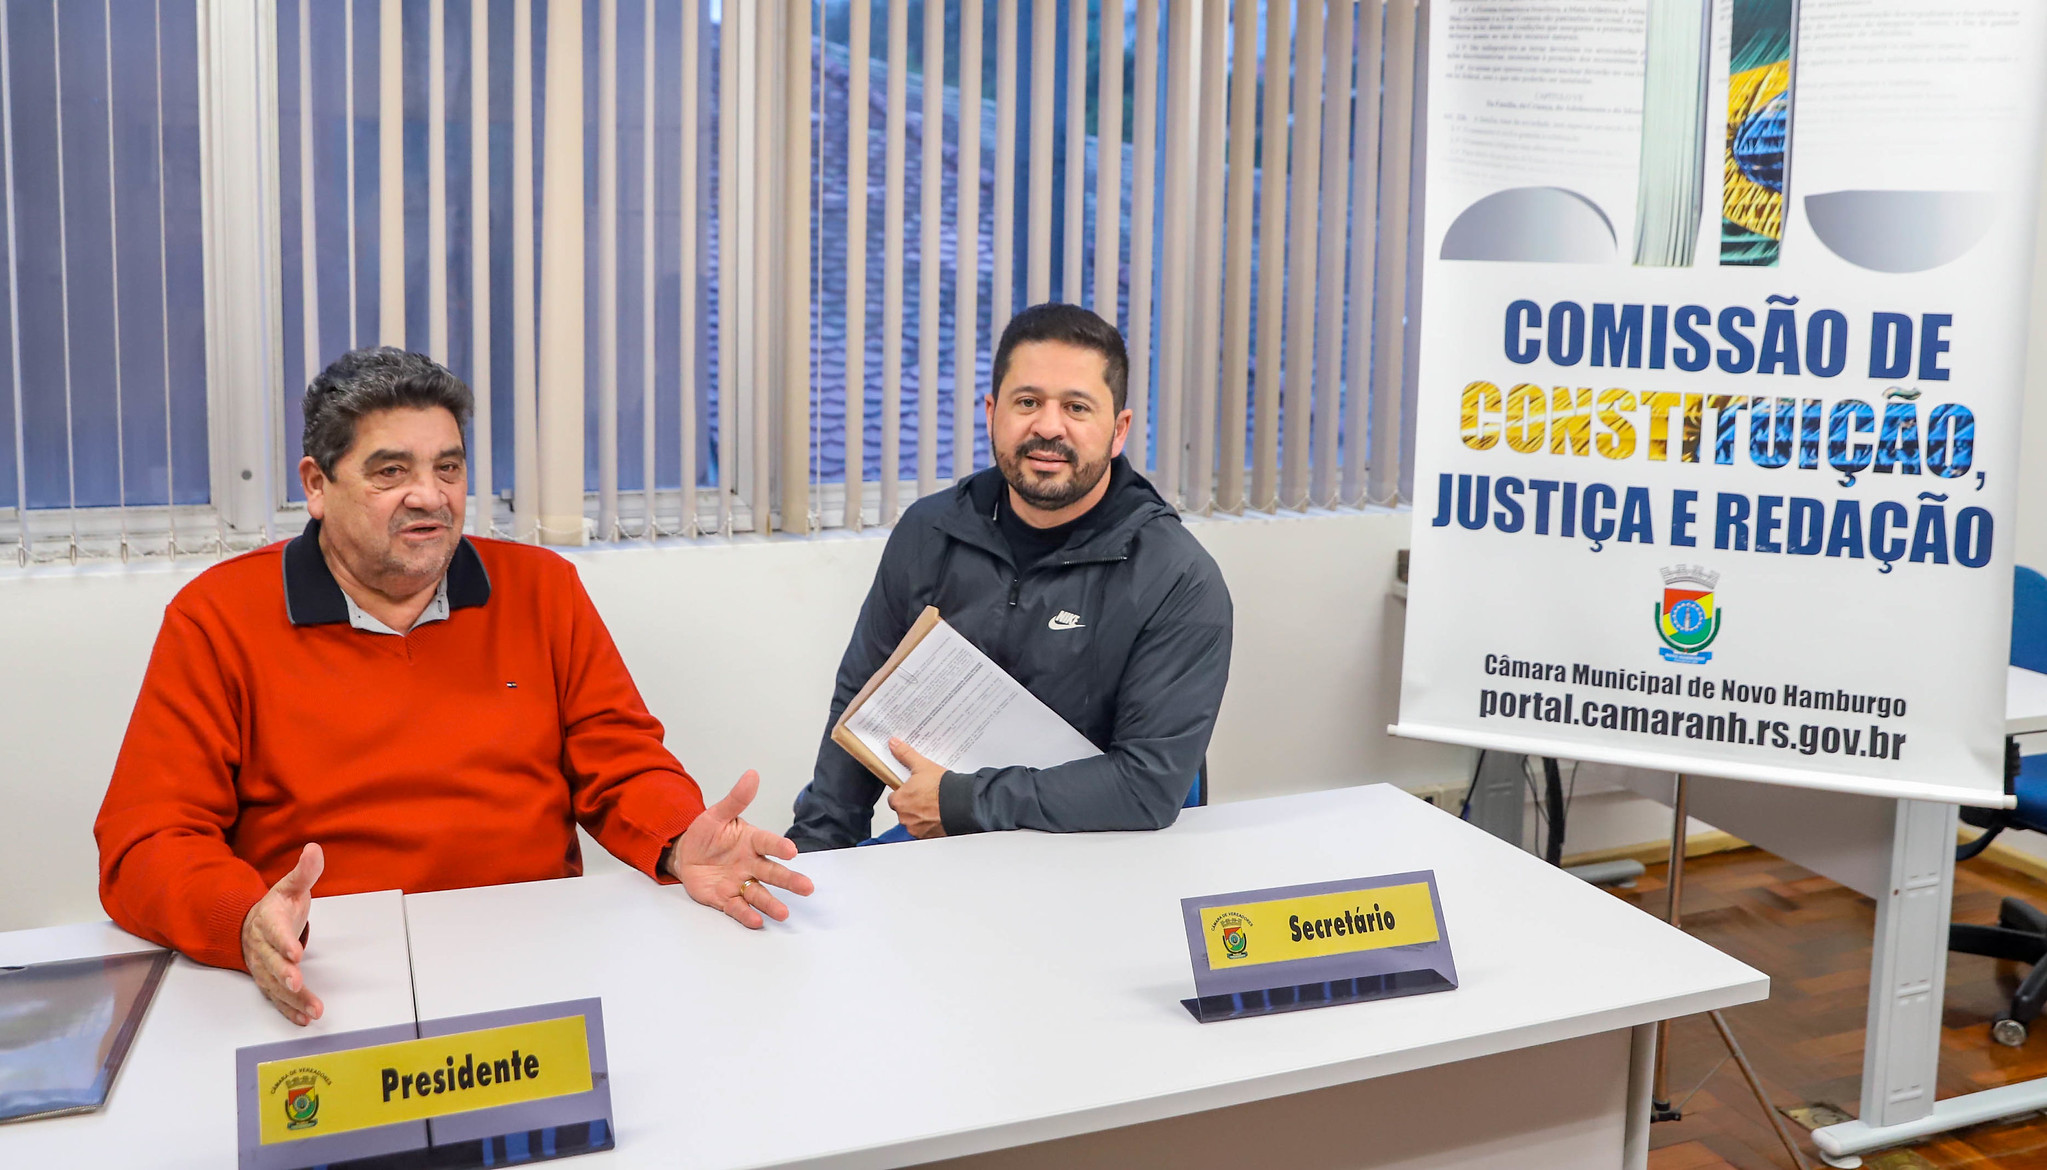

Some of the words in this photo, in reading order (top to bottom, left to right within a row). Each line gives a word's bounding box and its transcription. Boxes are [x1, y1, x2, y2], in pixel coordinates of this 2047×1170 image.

[1504, 294, 1848, 379] COMISSÃO
[1868, 311, 1953, 381] DE
[1459, 380, 1986, 491] CONSTITUIÇÃO,
[1432, 473, 1655, 553] JUSTIÇA
[1670, 489, 1698, 547] E
[1713, 491, 1994, 574] REDAÇÃO
[1055, 610, 1081, 625] NIKE
[1484, 653, 1567, 684] Câmara
[1572, 663, 1682, 697] Municipal
[1687, 675, 1715, 699] de
[1721, 679, 1777, 706] Novo
[1783, 684, 1907, 718] Hamburgo
[1479, 687, 1907, 761] portal.camaranh.rs.gov.br
[1289, 903, 1396, 942] Secretário
[381, 1049, 540, 1103] Presidente
